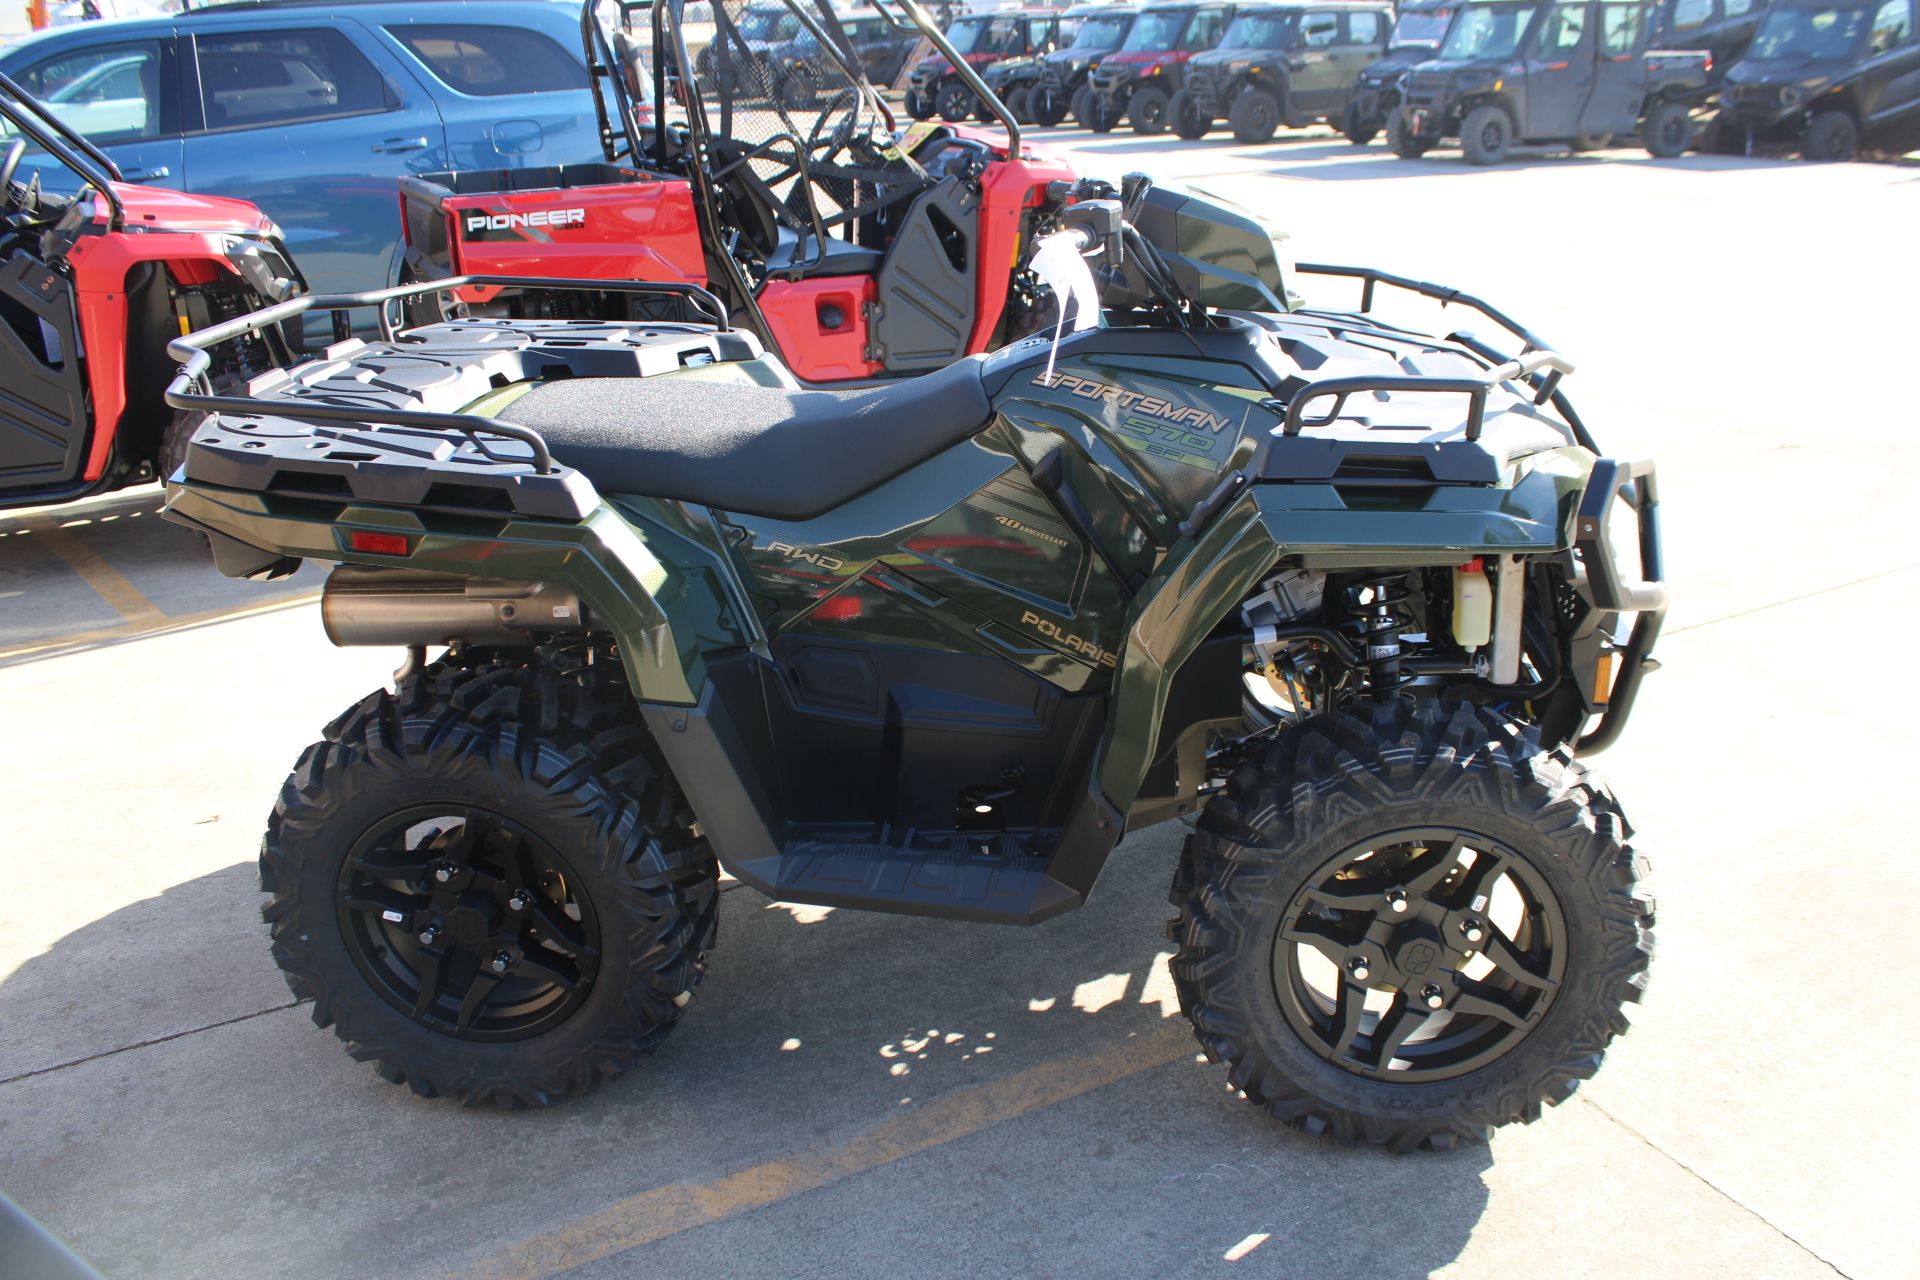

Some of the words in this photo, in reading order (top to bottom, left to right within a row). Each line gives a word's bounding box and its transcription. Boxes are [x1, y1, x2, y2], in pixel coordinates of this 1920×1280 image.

[467, 208, 585, 232] PIONEER
[1030, 370, 1231, 434] SPORTSMAN
[1121, 416, 1216, 451] 570
[1145, 443, 1184, 461] EFI
[994, 515, 1022, 529] 40
[1018, 526, 1070, 547] ANNIVERSARY
[766, 541, 844, 571] AWD
[1021, 610, 1117, 668] POLARIS
